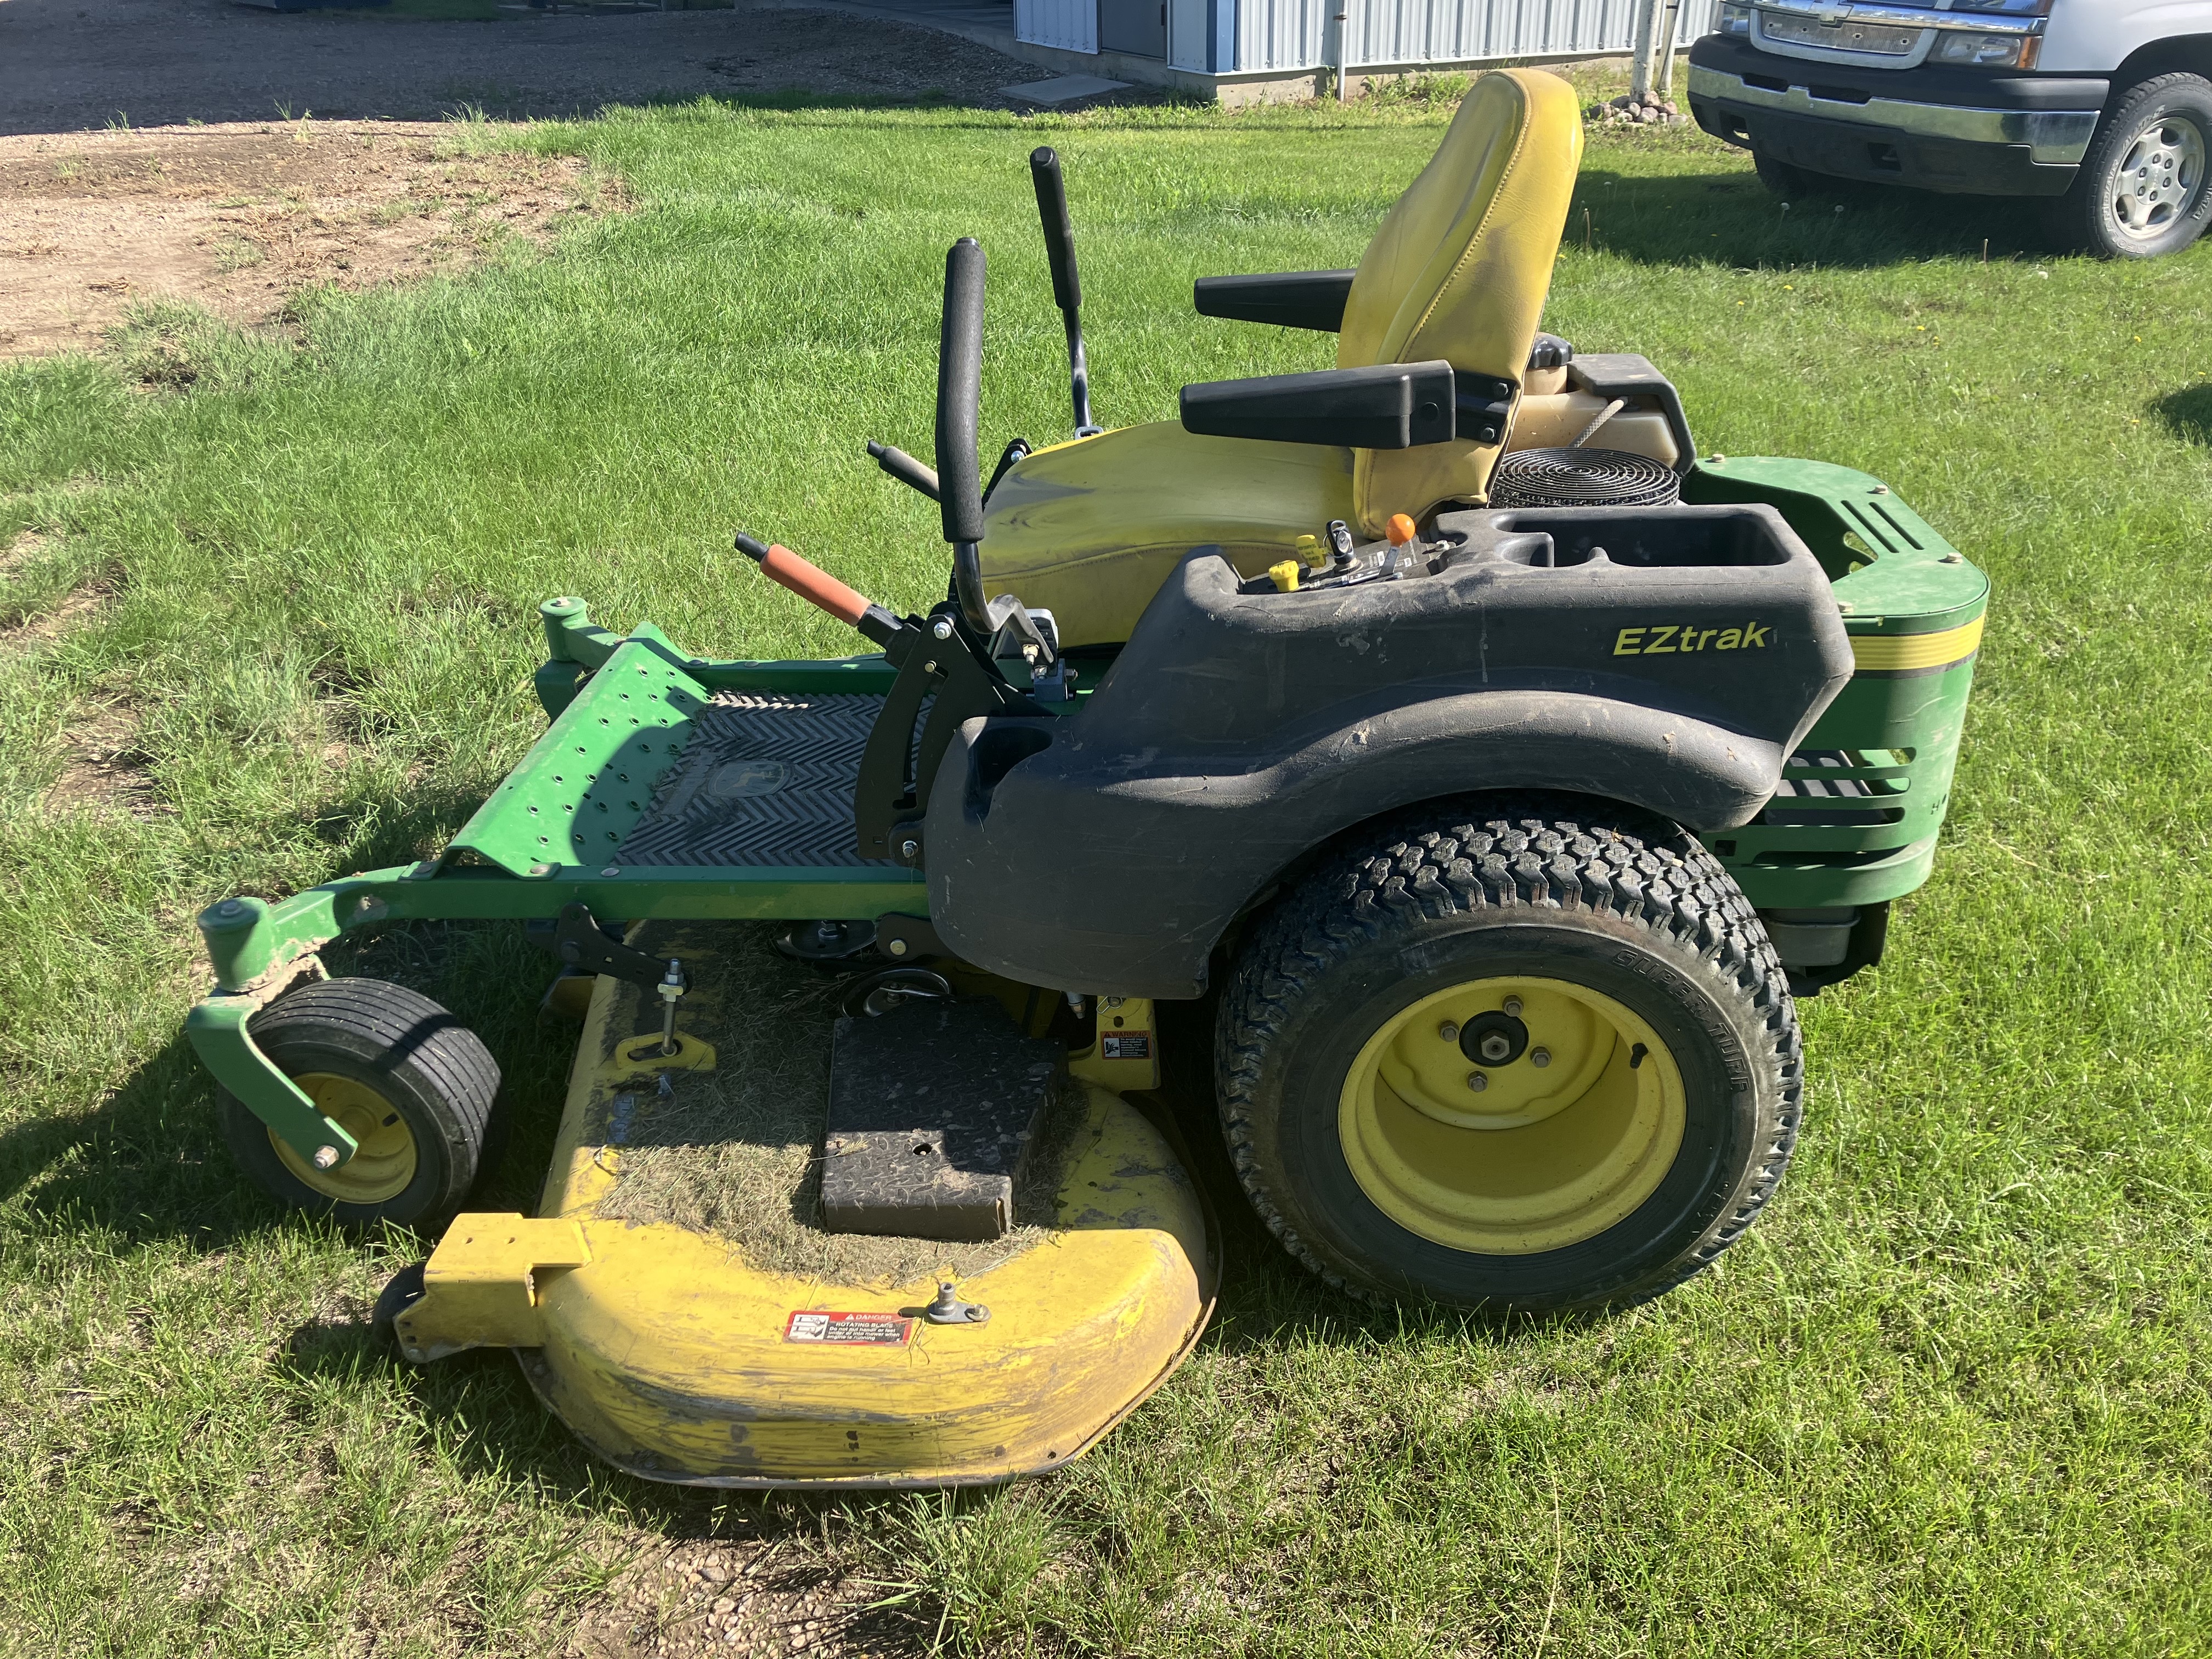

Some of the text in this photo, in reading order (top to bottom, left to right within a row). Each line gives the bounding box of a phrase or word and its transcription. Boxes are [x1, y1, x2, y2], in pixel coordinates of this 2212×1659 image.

[2102, 159, 2147, 255] GEOLANDAR
[1613, 621, 1772, 656] EZtrak
[1613, 949, 1750, 1092] SUPER TURF
